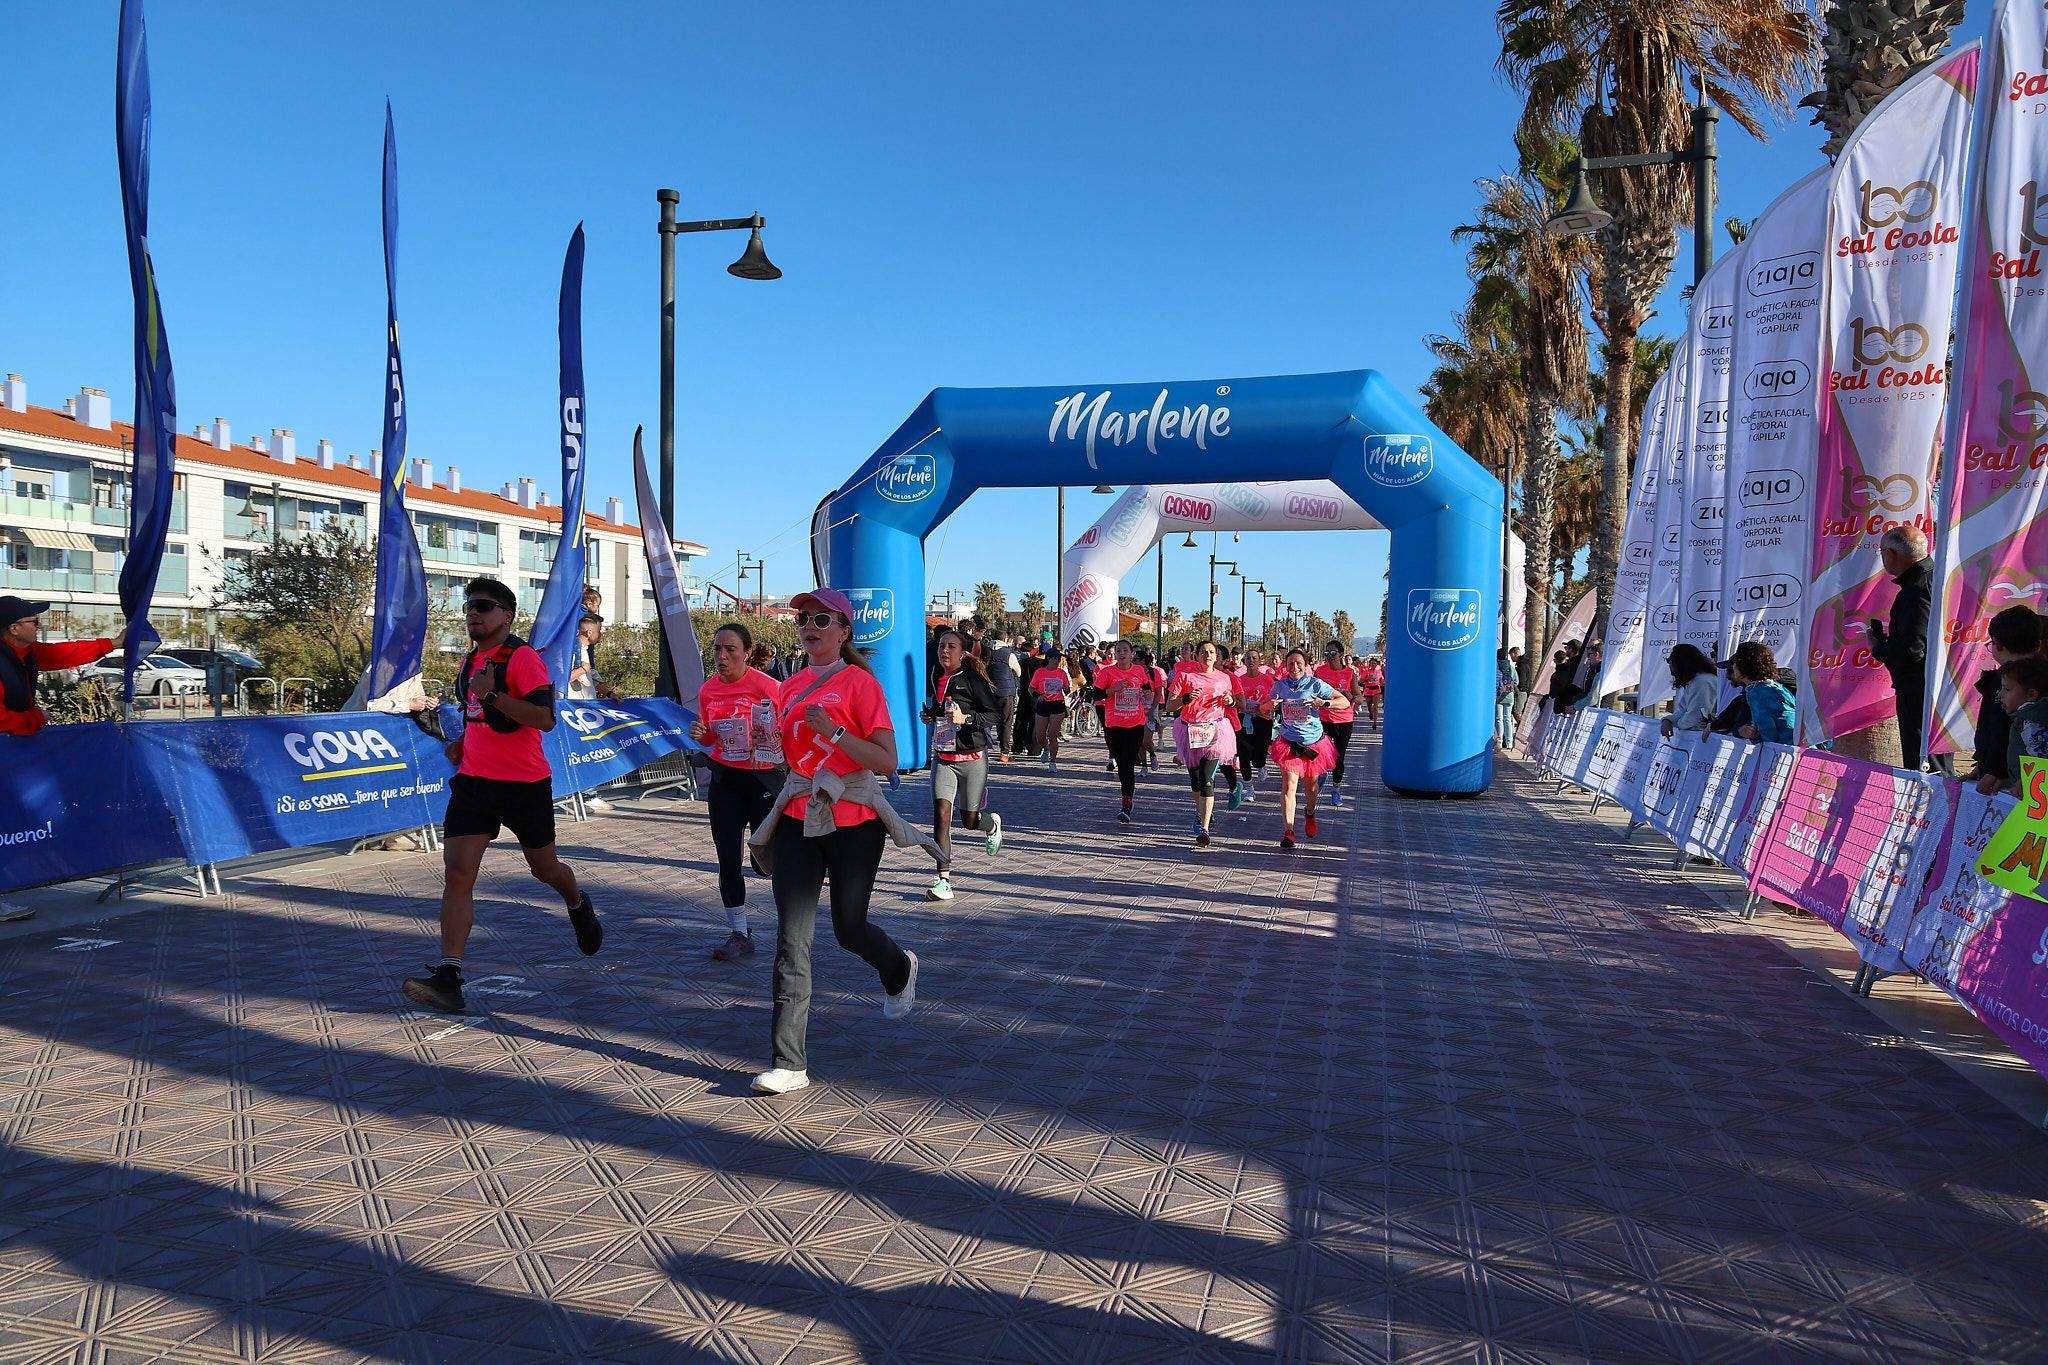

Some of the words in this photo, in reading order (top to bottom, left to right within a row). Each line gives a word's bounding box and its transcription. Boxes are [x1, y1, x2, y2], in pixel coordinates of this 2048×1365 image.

[2009, 71, 2048, 100] Sa
[1836, 231, 1877, 257] Sal
[1884, 222, 1959, 251] Costa
[1857, 258, 1898, 269] Desde
[1905, 251, 1934, 264] 1925
[1987, 249, 2041, 280] Sal
[2013, 286, 2045, 298] Des
[1827, 368, 1870, 392] Sal
[1849, 395, 1890, 405] Desde
[1896, 391, 1926, 401] 1925
[1048, 387, 1231, 470] Marlene
[1369, 445, 1430, 474] Marlene
[1965, 444, 2020, 473] Sal
[880, 465, 932, 490] Marlene
[1163, 494, 1212, 522] COSMO
[1288, 495, 1339, 521] COSMO
[1821, 515, 1860, 538] Sal
[1411, 602, 1477, 634] Marlene
[1452, 633, 1472, 646] ALPES
[283, 728, 400, 771] GOYA
[590, 747, 615, 761] GOYA
[298, 799, 312, 812] es
[312, 792, 350, 808] GOYA
[381, 787, 398, 809] que
[399, 785, 415, 798] ser
[2026, 770, 2048, 821] S
[1785, 821, 1809, 852] Sal
[1952, 901, 1976, 924] Costa
